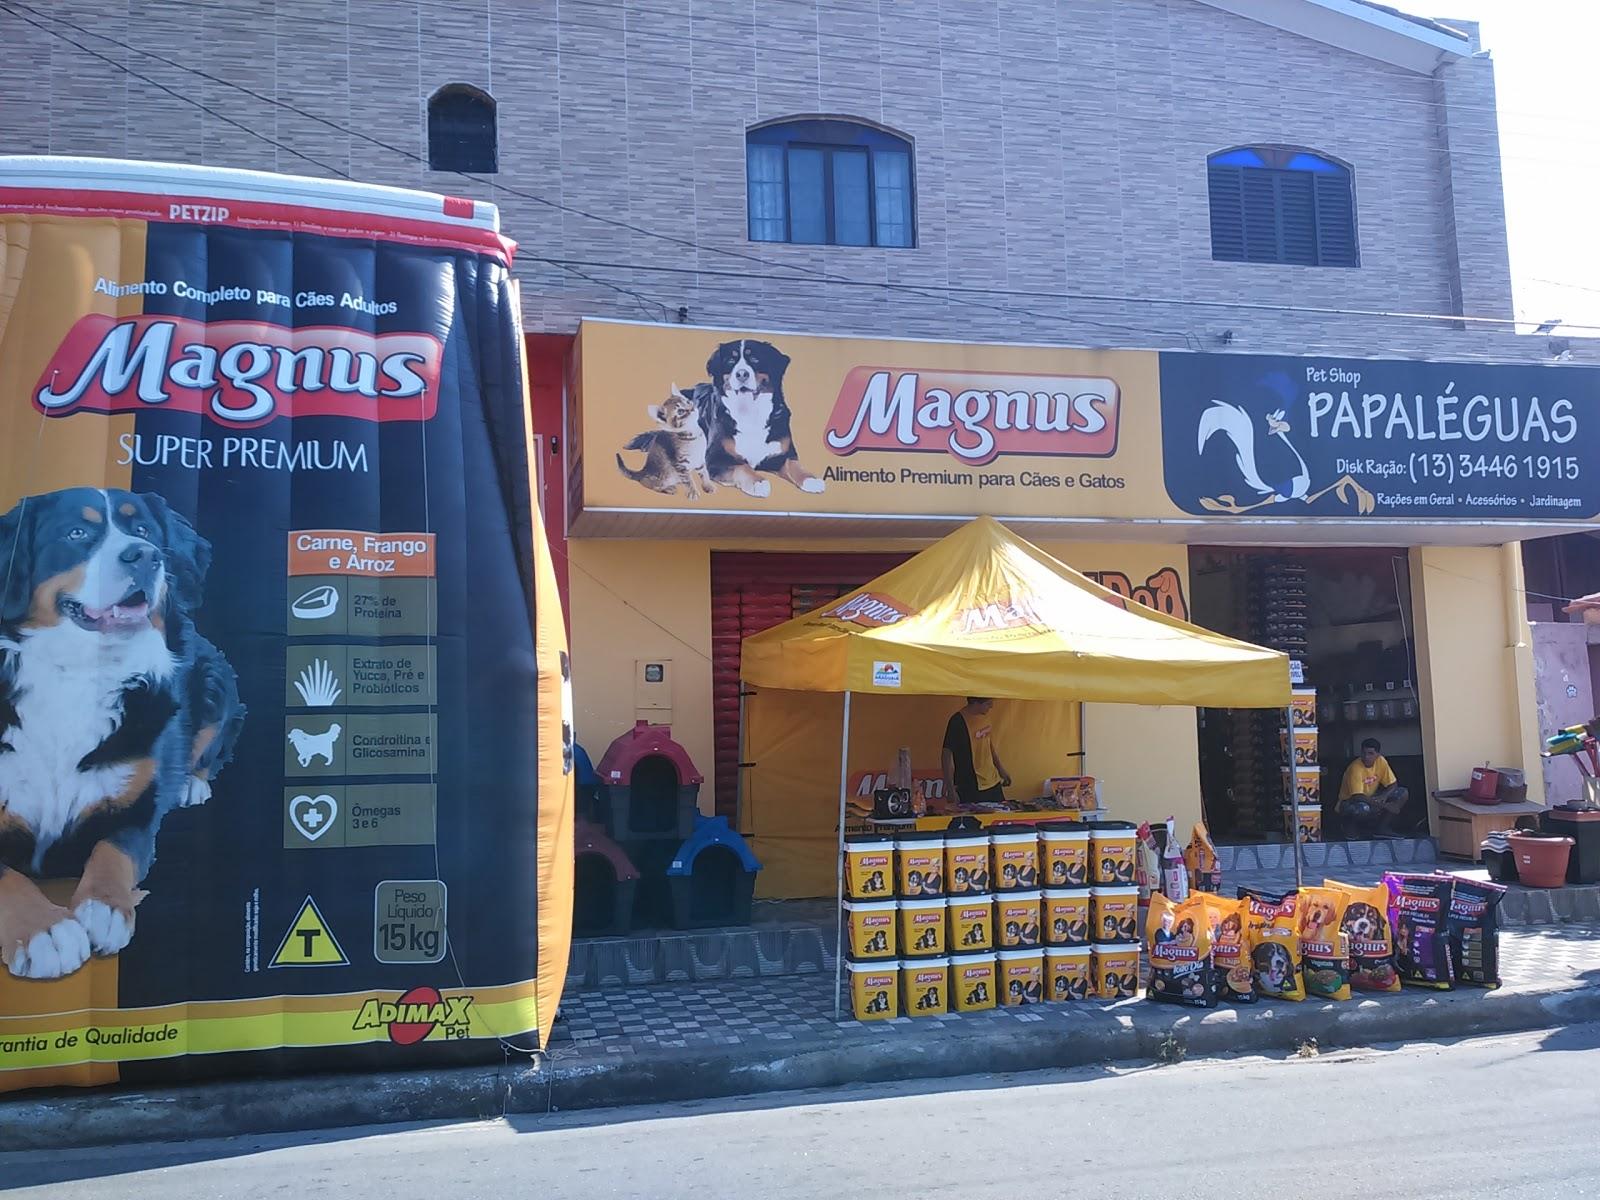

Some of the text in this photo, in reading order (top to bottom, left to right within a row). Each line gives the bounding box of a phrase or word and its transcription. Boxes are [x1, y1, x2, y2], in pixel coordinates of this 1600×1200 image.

[169, 204, 230, 223] PETZIP
[94, 278, 398, 315] Alimento Completo para Cães Adultos
[38, 321, 426, 422] Magnus
[1306, 367, 1361, 388] Pet Shop
[827, 371, 1107, 460] Magnus
[1308, 381, 1578, 444] PAPALÉGUAS
[117, 433, 368, 473] SUPER PREMIUM
[1336, 452, 1580, 484] Disk Ração: (13) 3446 1915
[823, 466, 1125, 490] Alimento Premium para Cães e Gatos
[1377, 491, 1582, 510] Rações em Geral Acessórios Jardinagem
[297, 535, 427, 556] Carne, Frango
[329, 556, 341, 569] e
[382, 595, 397, 607] de
[354, 607, 402, 619] Proteína
[353, 658, 412, 670] Extrato de
[352, 669, 425, 682] Yucca, Pré e
[352, 682, 420, 695] Probióticos
[352, 734, 422, 747] Condroitina
[352, 747, 426, 759] Glicosamina
[352, 803, 401, 819] Ômegas
[352, 819, 379, 829] 3 e 6
[394, 889, 427, 903] Peso
[1389, 895, 1439, 911] Magnus
[387, 904, 434, 921] Líquido
[296, 929, 321, 957] T
[1152, 945, 1196, 960] Magnus
[353, 996, 474, 1031] ADIMAX
[55, 1032, 78, 1049] de
[86, 1024, 178, 1045] Qualidade
[445, 1026, 470, 1041] Pet
